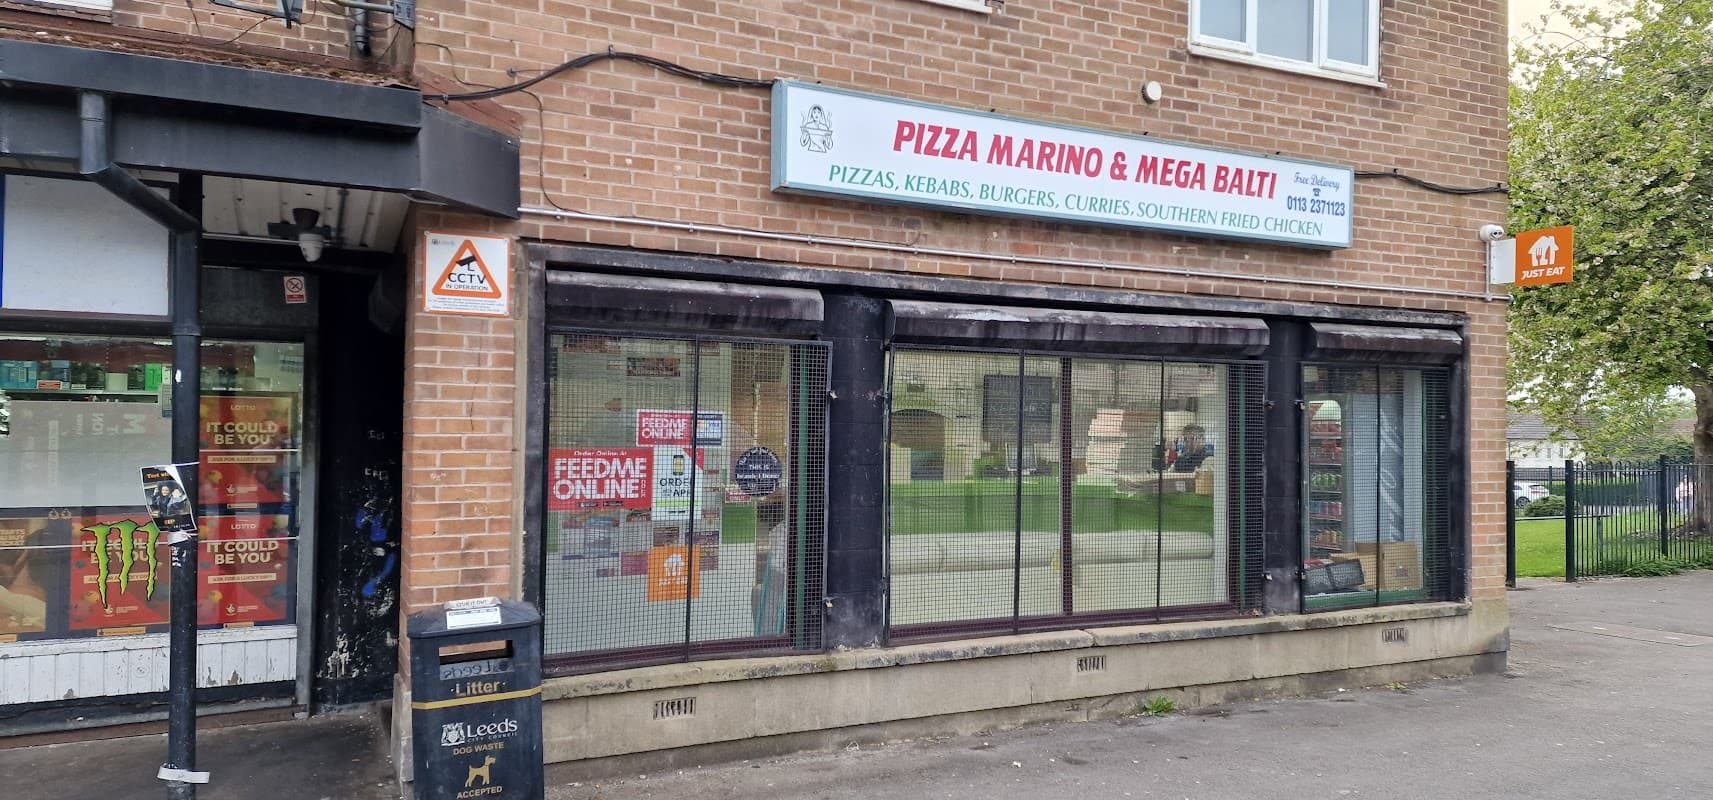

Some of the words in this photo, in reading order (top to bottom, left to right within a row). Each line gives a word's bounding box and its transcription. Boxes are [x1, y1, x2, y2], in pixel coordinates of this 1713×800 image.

[893, 120, 978, 162] PIZZA
[987, 134, 1103, 178] MARINO
[1109, 151, 1128, 181] &
[1135, 155, 1206, 190] MEGA
[1213, 165, 1278, 199] BALTI
[1293, 172, 1309, 184] Free
[1310, 174, 1340, 192] Delivery
[829, 164, 899, 191] PIZZAS,
[905, 174, 974, 199] KEBABS,
[979, 183, 1059, 210] BURGERS,
[1065, 193, 1135, 217] CURRIES,
[1136, 202, 1218, 225] SOUTHERN
[1221, 211, 1260, 230] FRIED
[1264, 217, 1324, 237] CHICKEN
[1287, 195, 1307, 212] 0113
[1310, 198, 1345, 217] 2371123
[448, 272, 486, 285] CCTV
[1521, 269, 1545, 280] JUST
[1545, 266, 1566, 277] EAT
[206, 422, 221, 433] IT
[224, 421, 279, 433] COULD
[642, 417, 689, 428] FEEDME
[214, 434, 235, 445] BE
[238, 434, 272, 445] YOU
[642, 428, 684, 439] ONLINE
[554, 458, 647, 479] FEEDME
[553, 479, 640, 500] ONLINE
[660, 478, 693, 487] ORDE
[206, 542, 222, 553] IT
[224, 540, 279, 552] COULD
[215, 553, 235, 565] BE
[238, 552, 271, 564] YOU
[455, 681, 500, 697] Litter
[467, 718, 518, 738] Leeds
[488, 732, 518, 740] COUNCIL
[453, 746, 473, 756] DOG
[474, 742, 504, 753] WASTE
[456, 786, 503, 800] ACCEPTED
